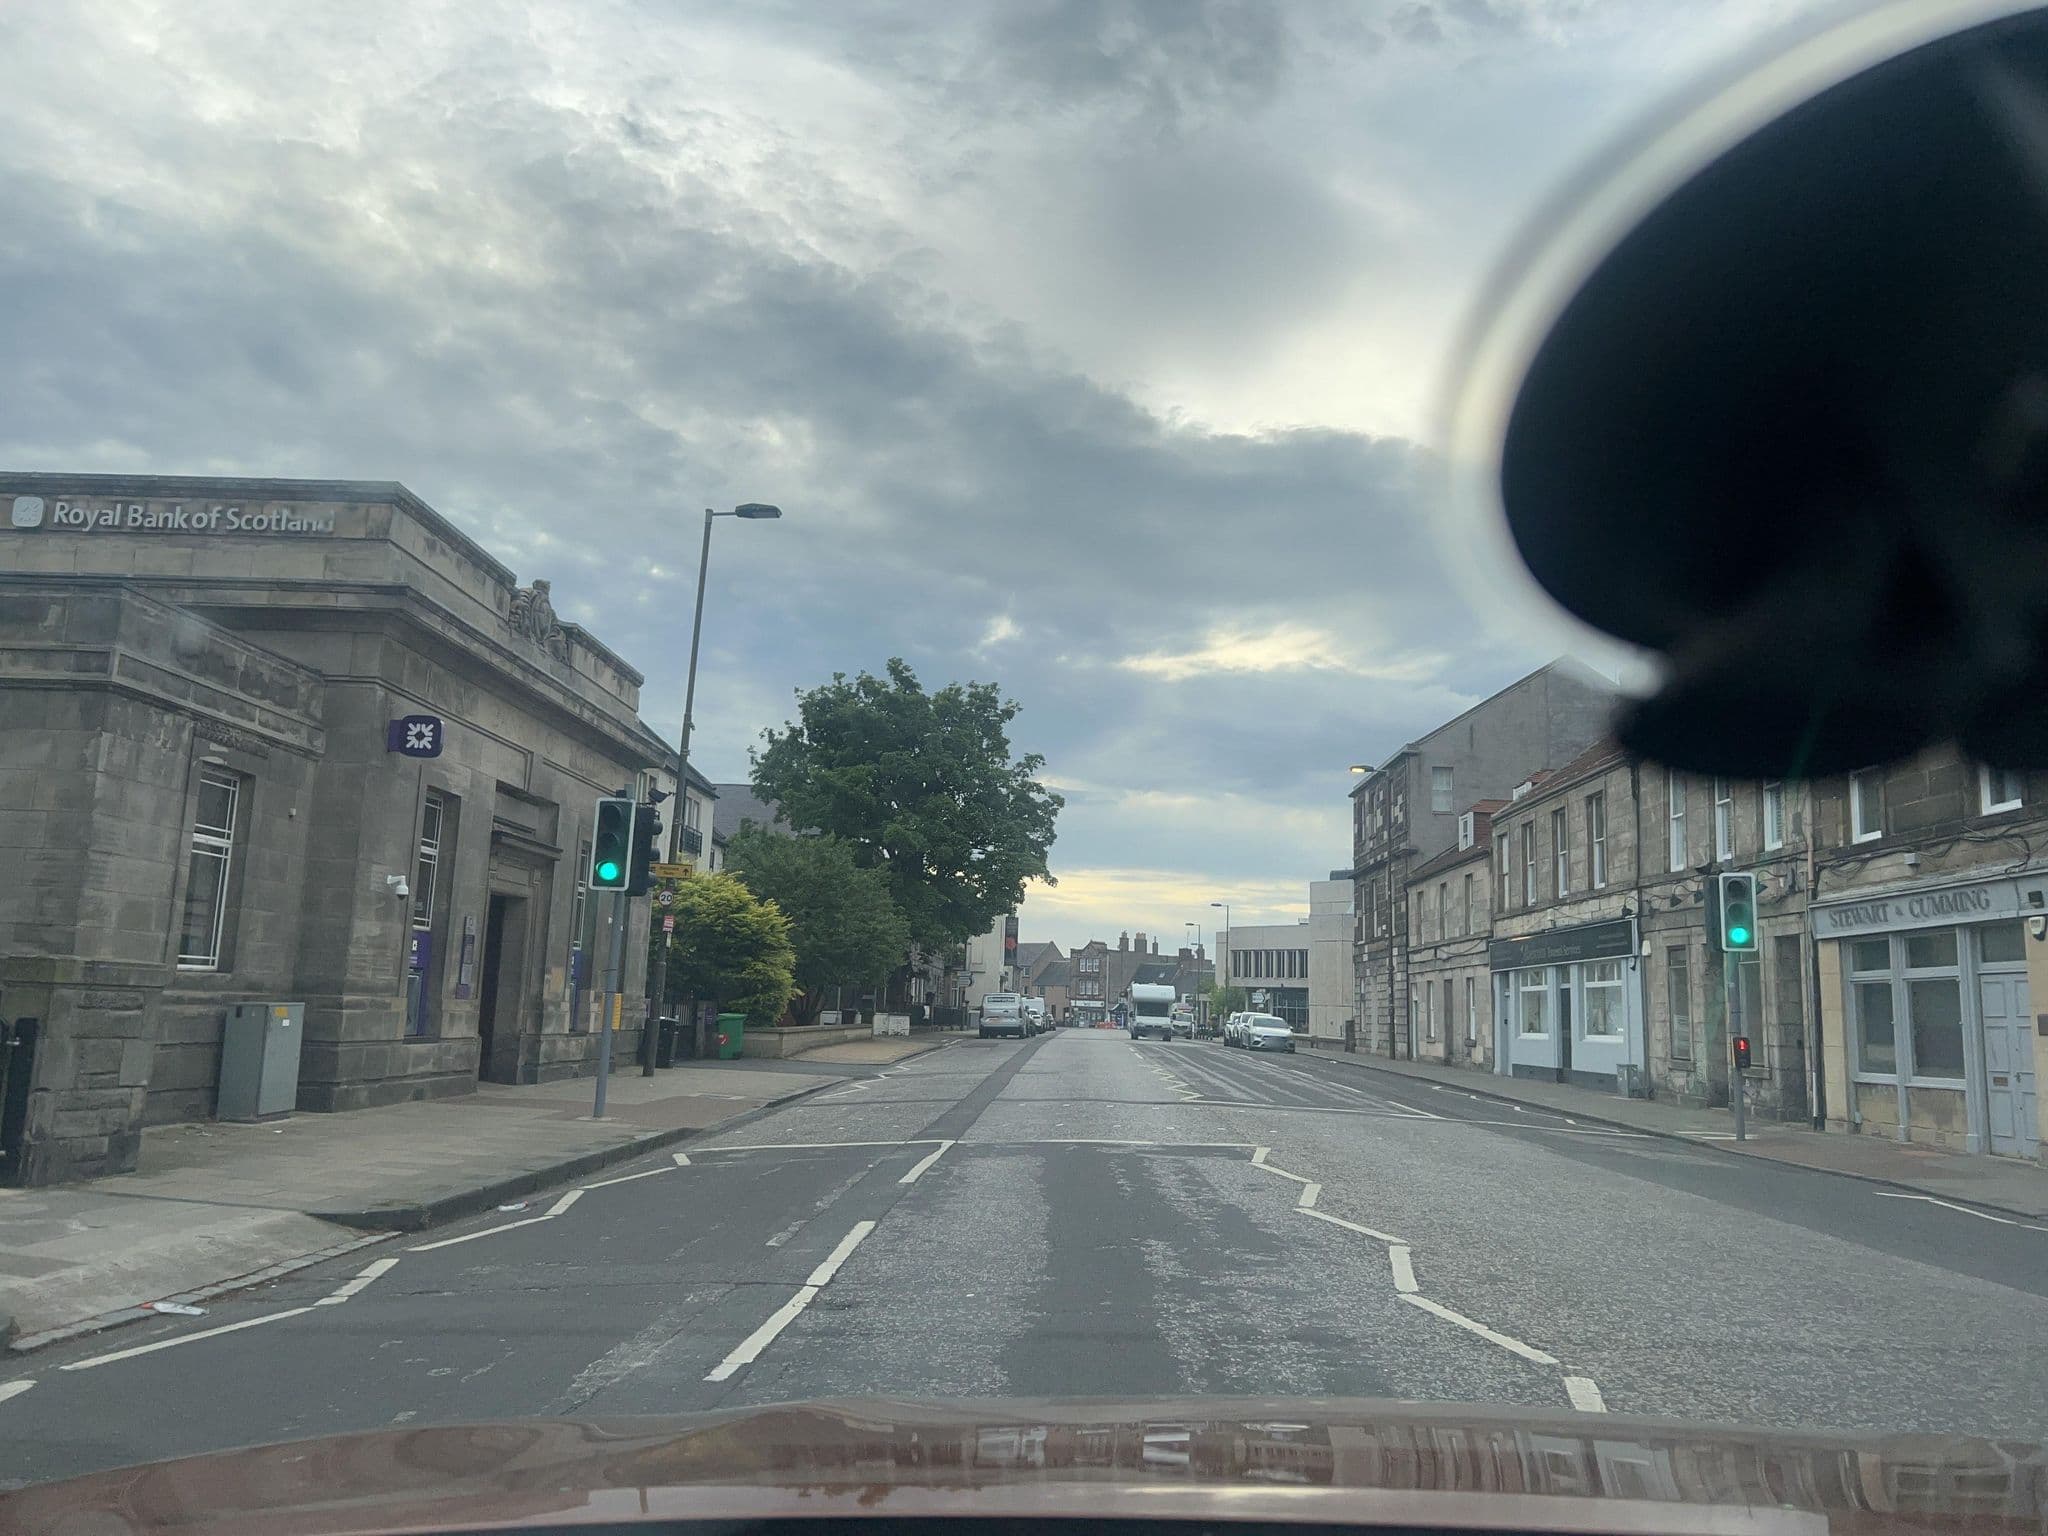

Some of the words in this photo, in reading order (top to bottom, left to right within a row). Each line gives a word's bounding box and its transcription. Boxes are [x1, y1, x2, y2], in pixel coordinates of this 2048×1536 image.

[54, 501, 121, 532] Royal
[127, 504, 188, 529] Bank
[191, 506, 222, 529] of
[660, 894, 673, 902] 20
[1828, 903, 1889, 929] STEWART
[1908, 888, 1990, 919] CUMMING
